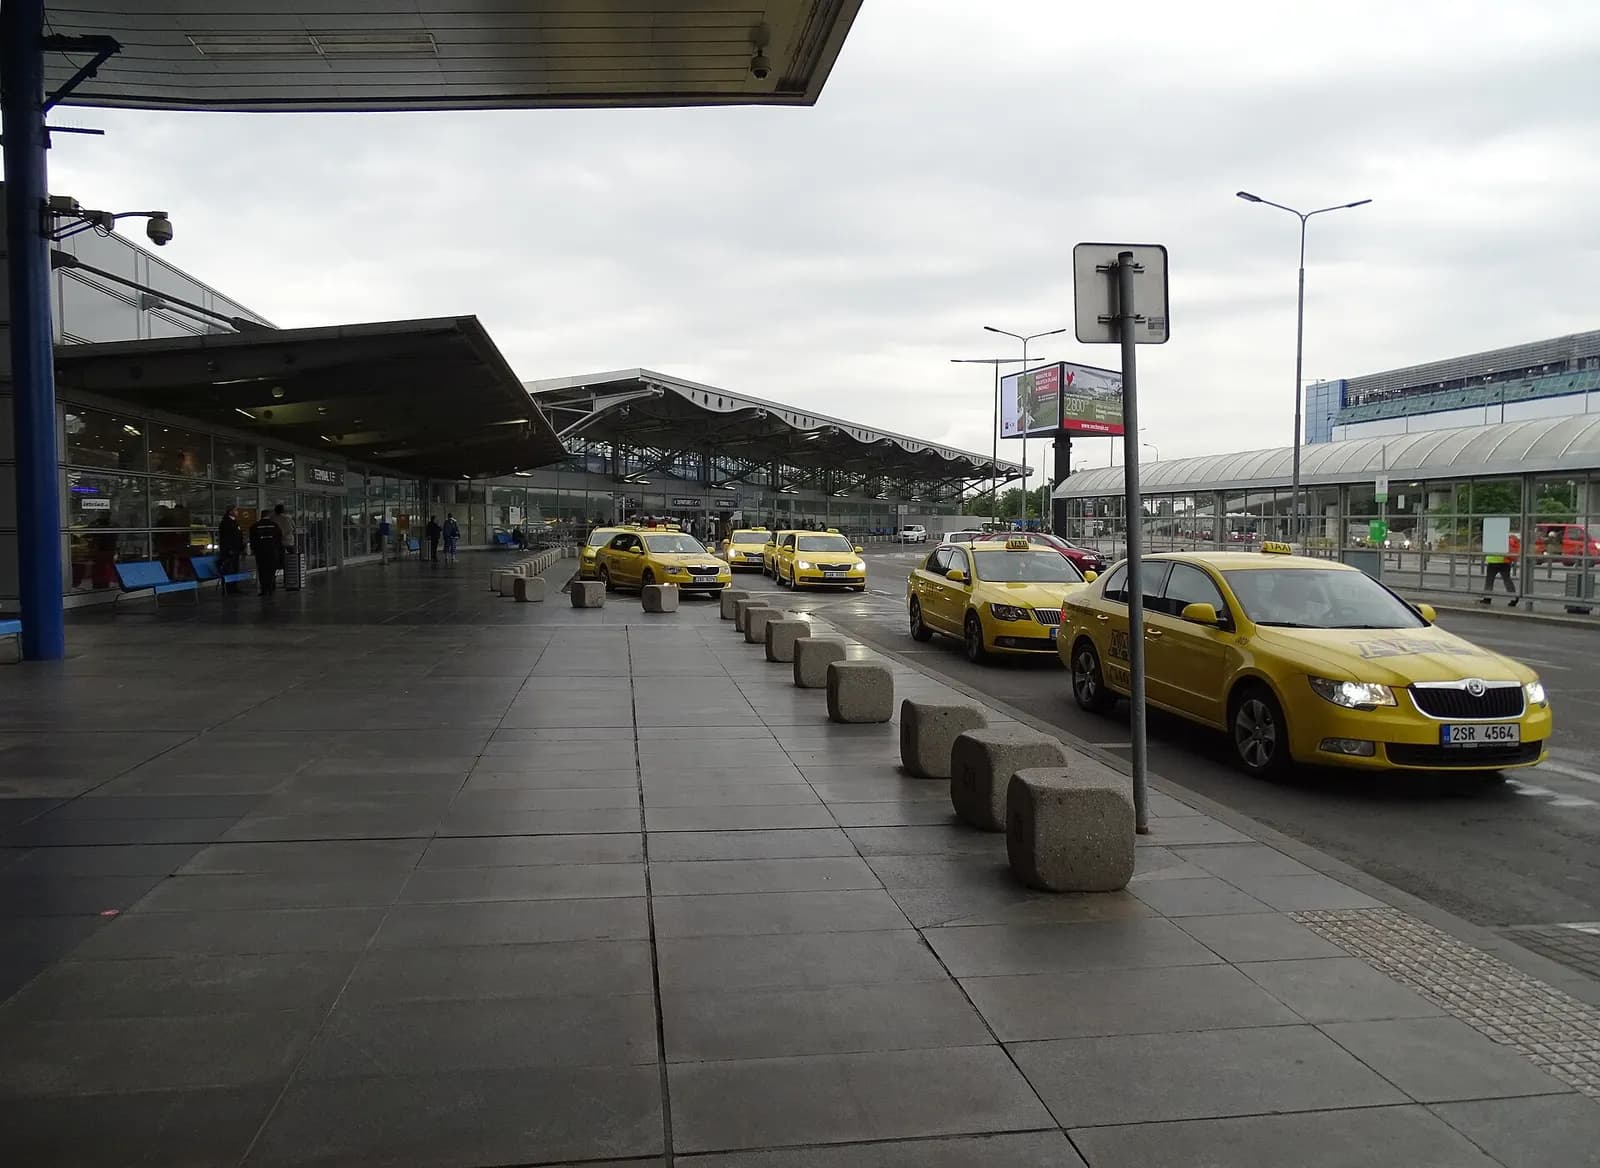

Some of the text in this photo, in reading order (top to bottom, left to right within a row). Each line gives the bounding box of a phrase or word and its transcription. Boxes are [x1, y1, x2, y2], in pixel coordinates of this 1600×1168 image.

[1269, 543, 1291, 552] TAXI
[1453, 727, 1475, 741] 2SR
[1485, 726, 1514, 740] 4564
